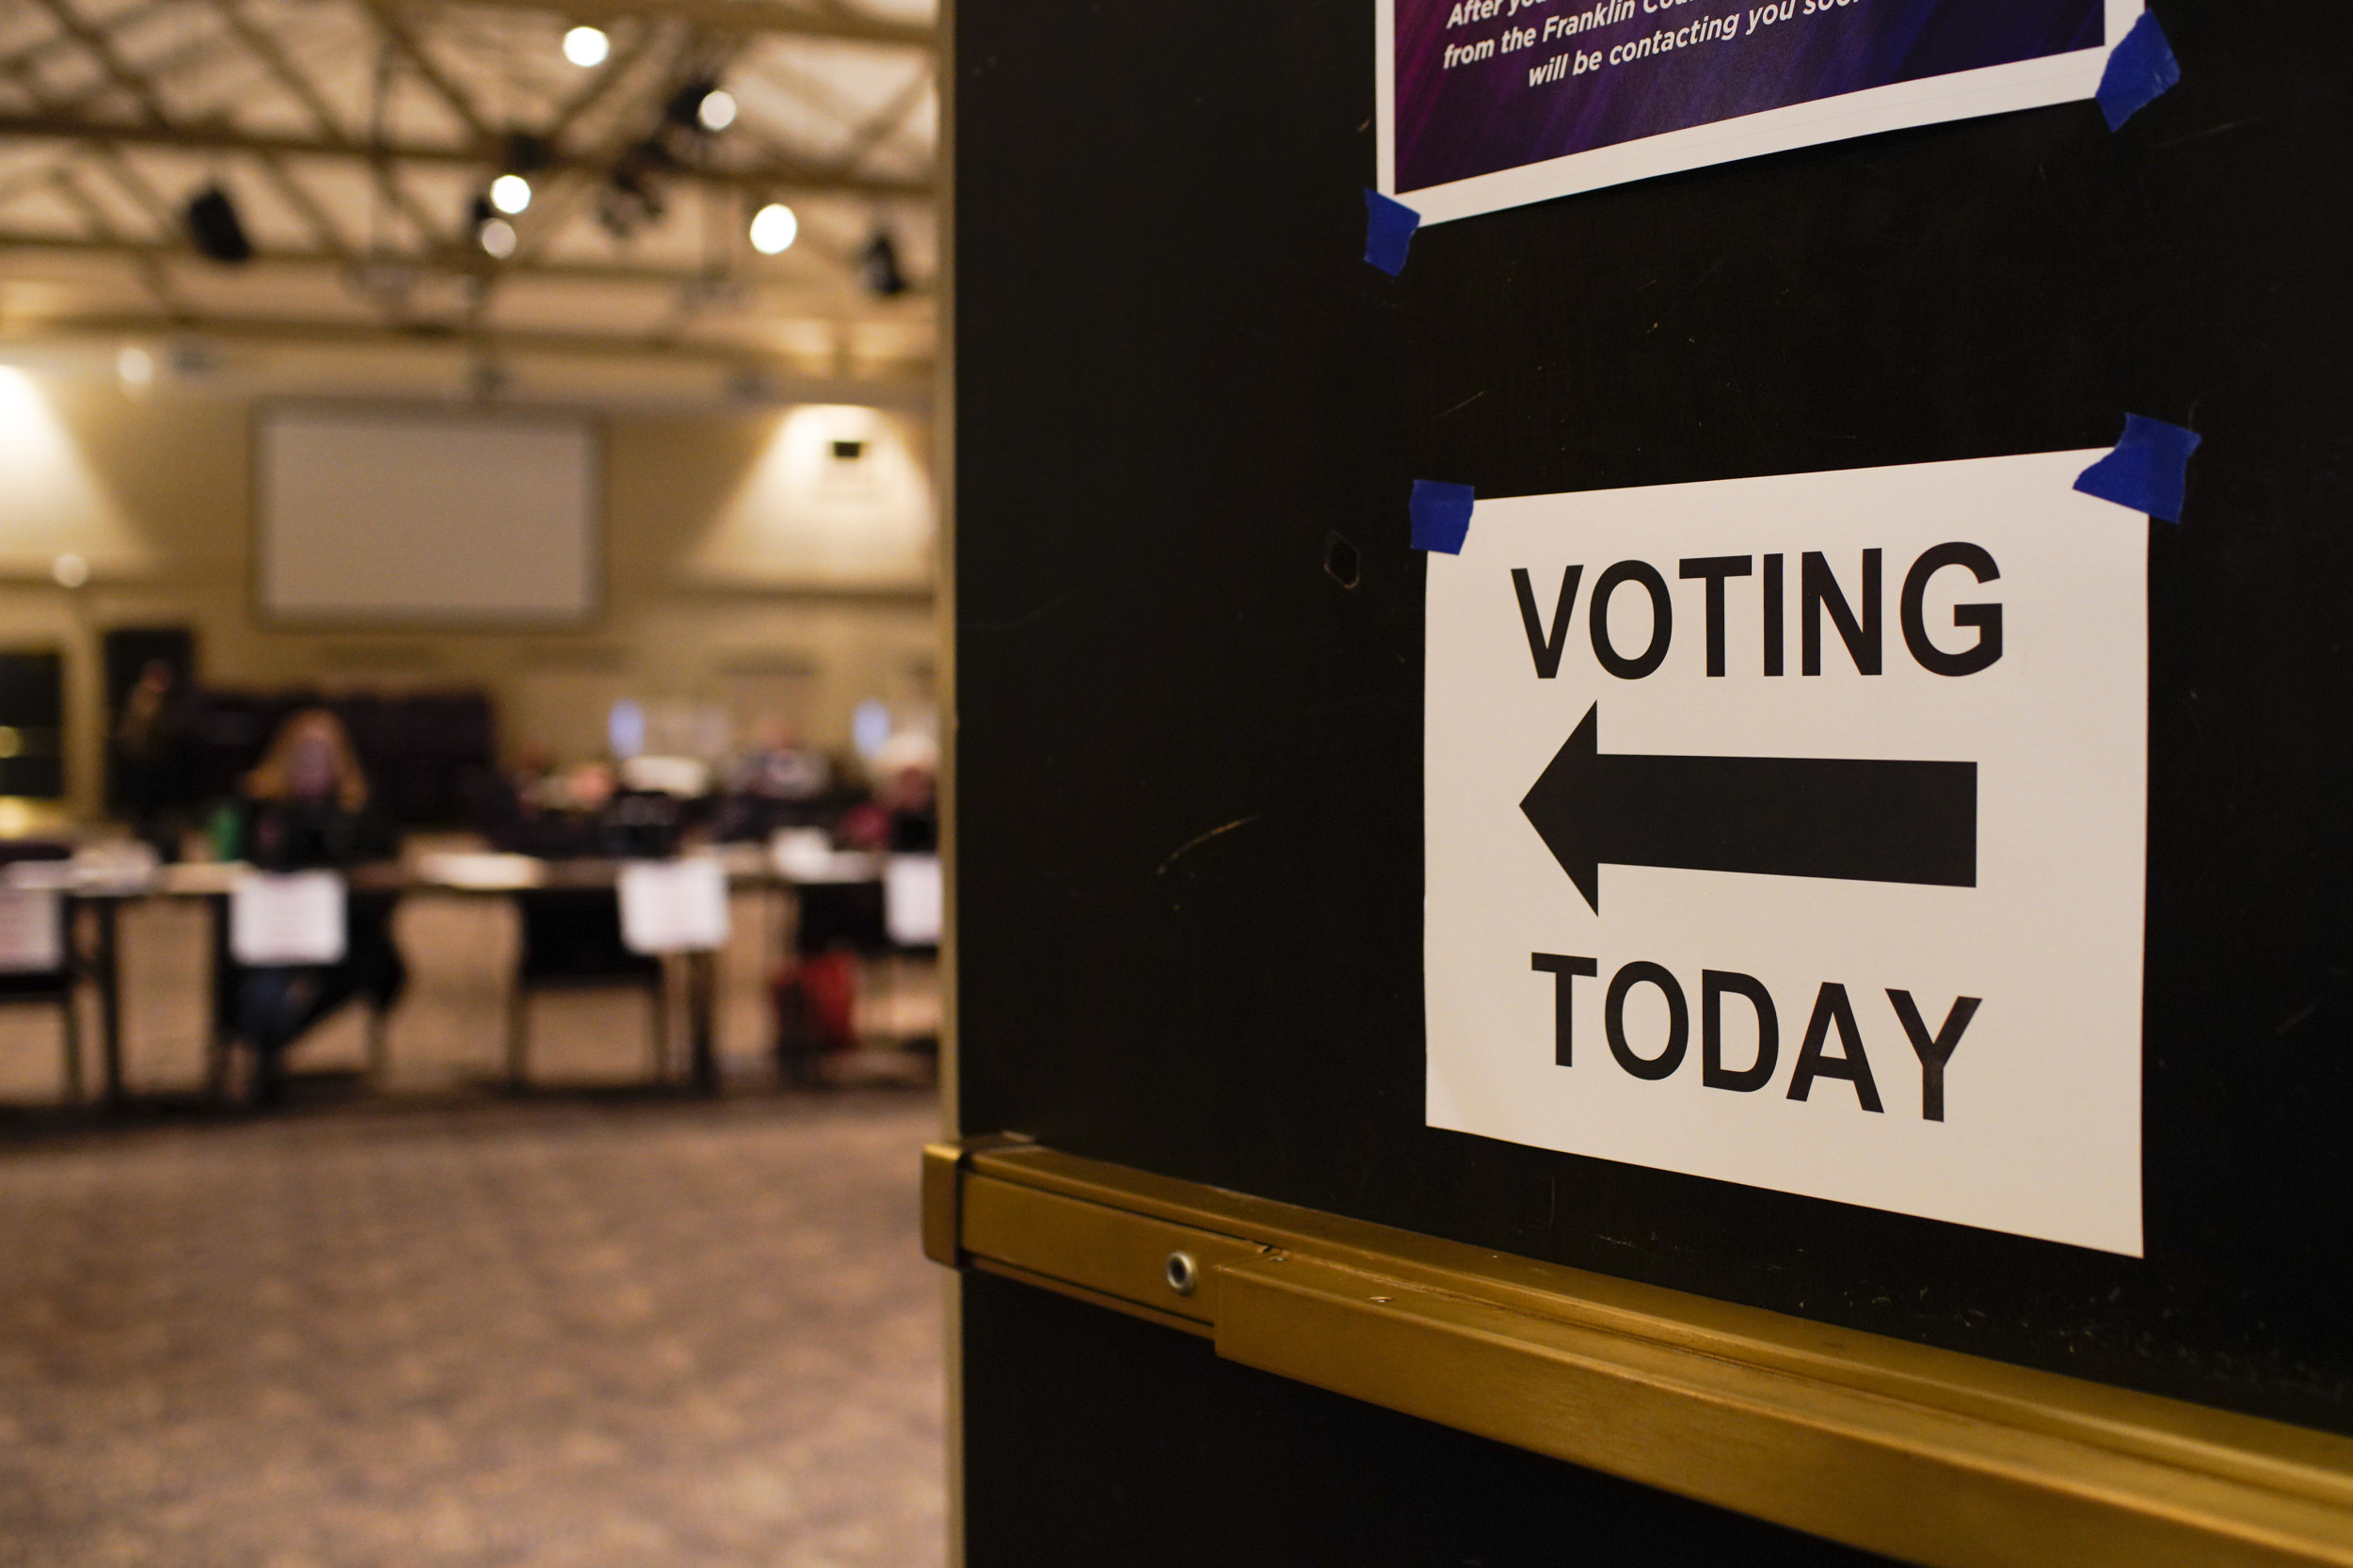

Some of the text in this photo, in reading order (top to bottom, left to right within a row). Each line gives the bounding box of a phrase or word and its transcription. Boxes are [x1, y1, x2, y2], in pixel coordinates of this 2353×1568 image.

[1443, 40, 1496, 70] from
[1500, 26, 1537, 54] the
[1542, 0, 1636, 42] Franklin
[1446, 0, 1505, 29] After
[1529, 53, 1569, 88] will
[1572, 49, 1603, 76] be
[1609, 14, 1740, 66] contacting
[1745, 0, 1797, 36] you
[1511, 541, 2003, 680] VOTING
[1530, 952, 1983, 1123] TODAY
